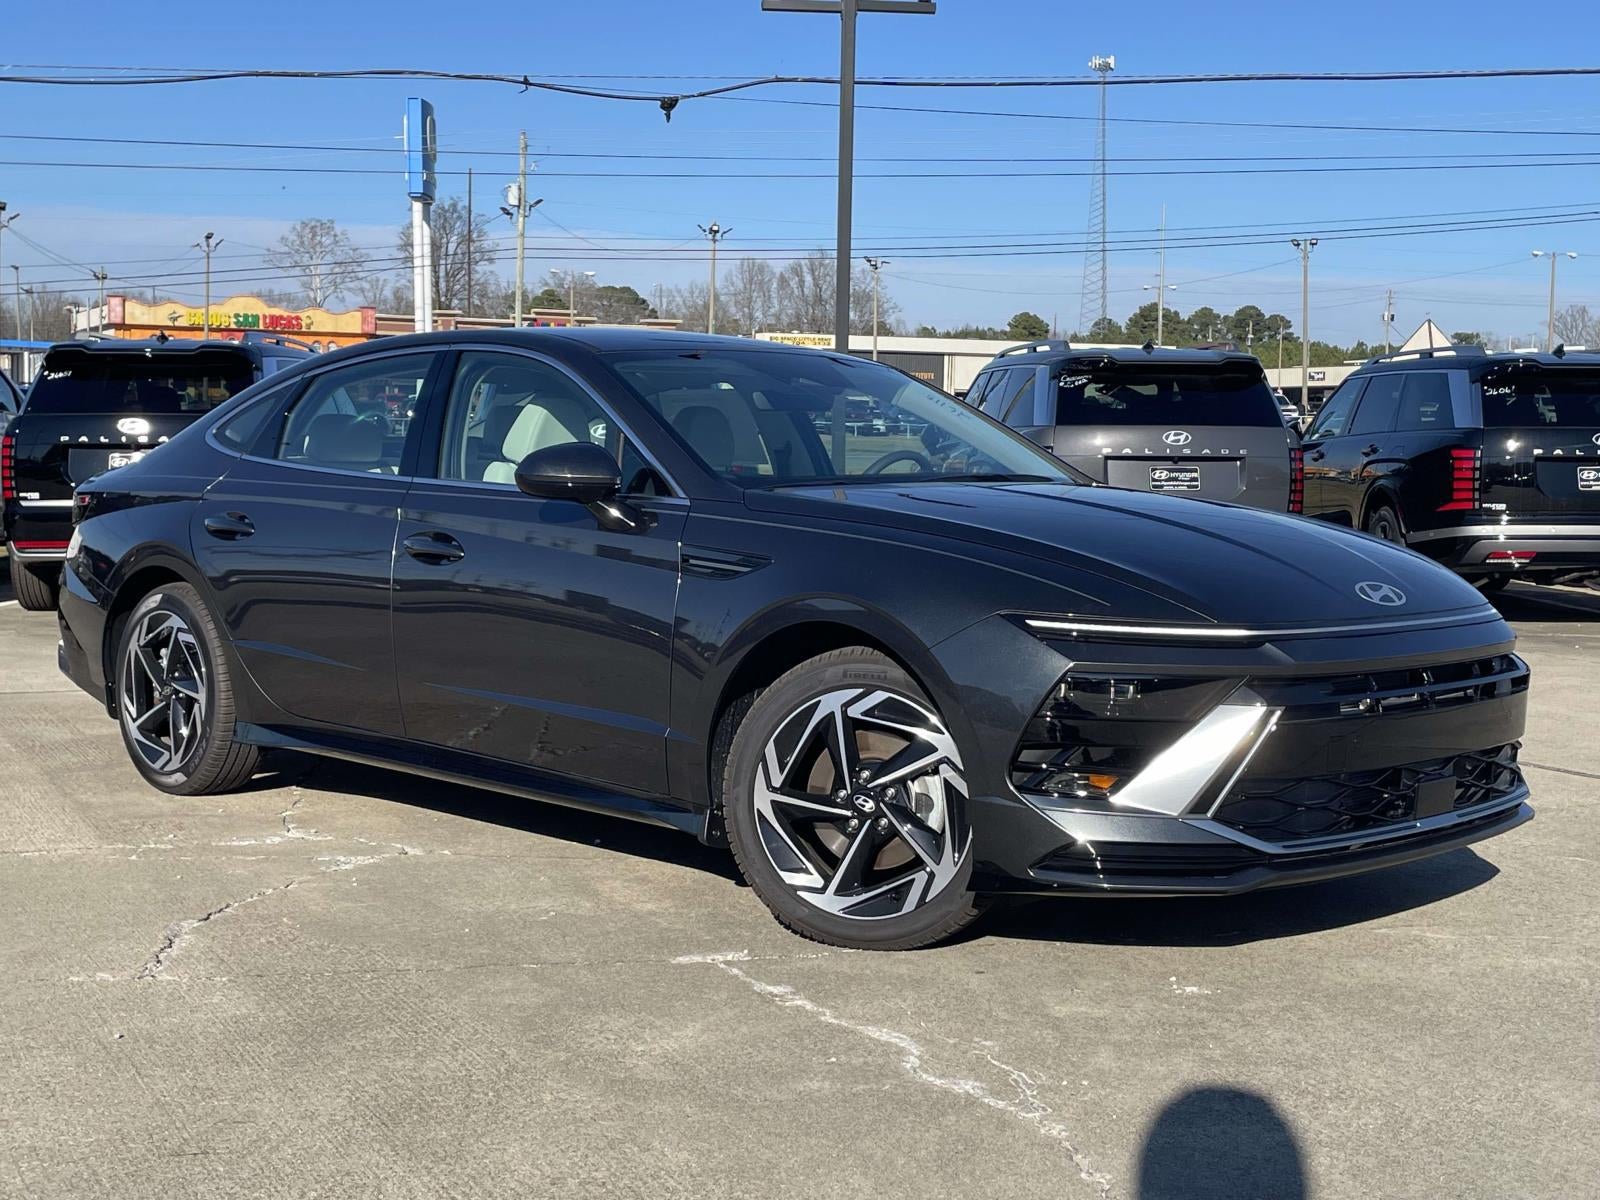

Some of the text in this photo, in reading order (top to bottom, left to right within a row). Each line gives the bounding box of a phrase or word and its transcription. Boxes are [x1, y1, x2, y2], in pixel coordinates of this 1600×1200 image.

[233, 312, 260, 328] SAN
[262, 314, 303, 330] LUCAS
[842, 669, 888, 680] PIRELLI
